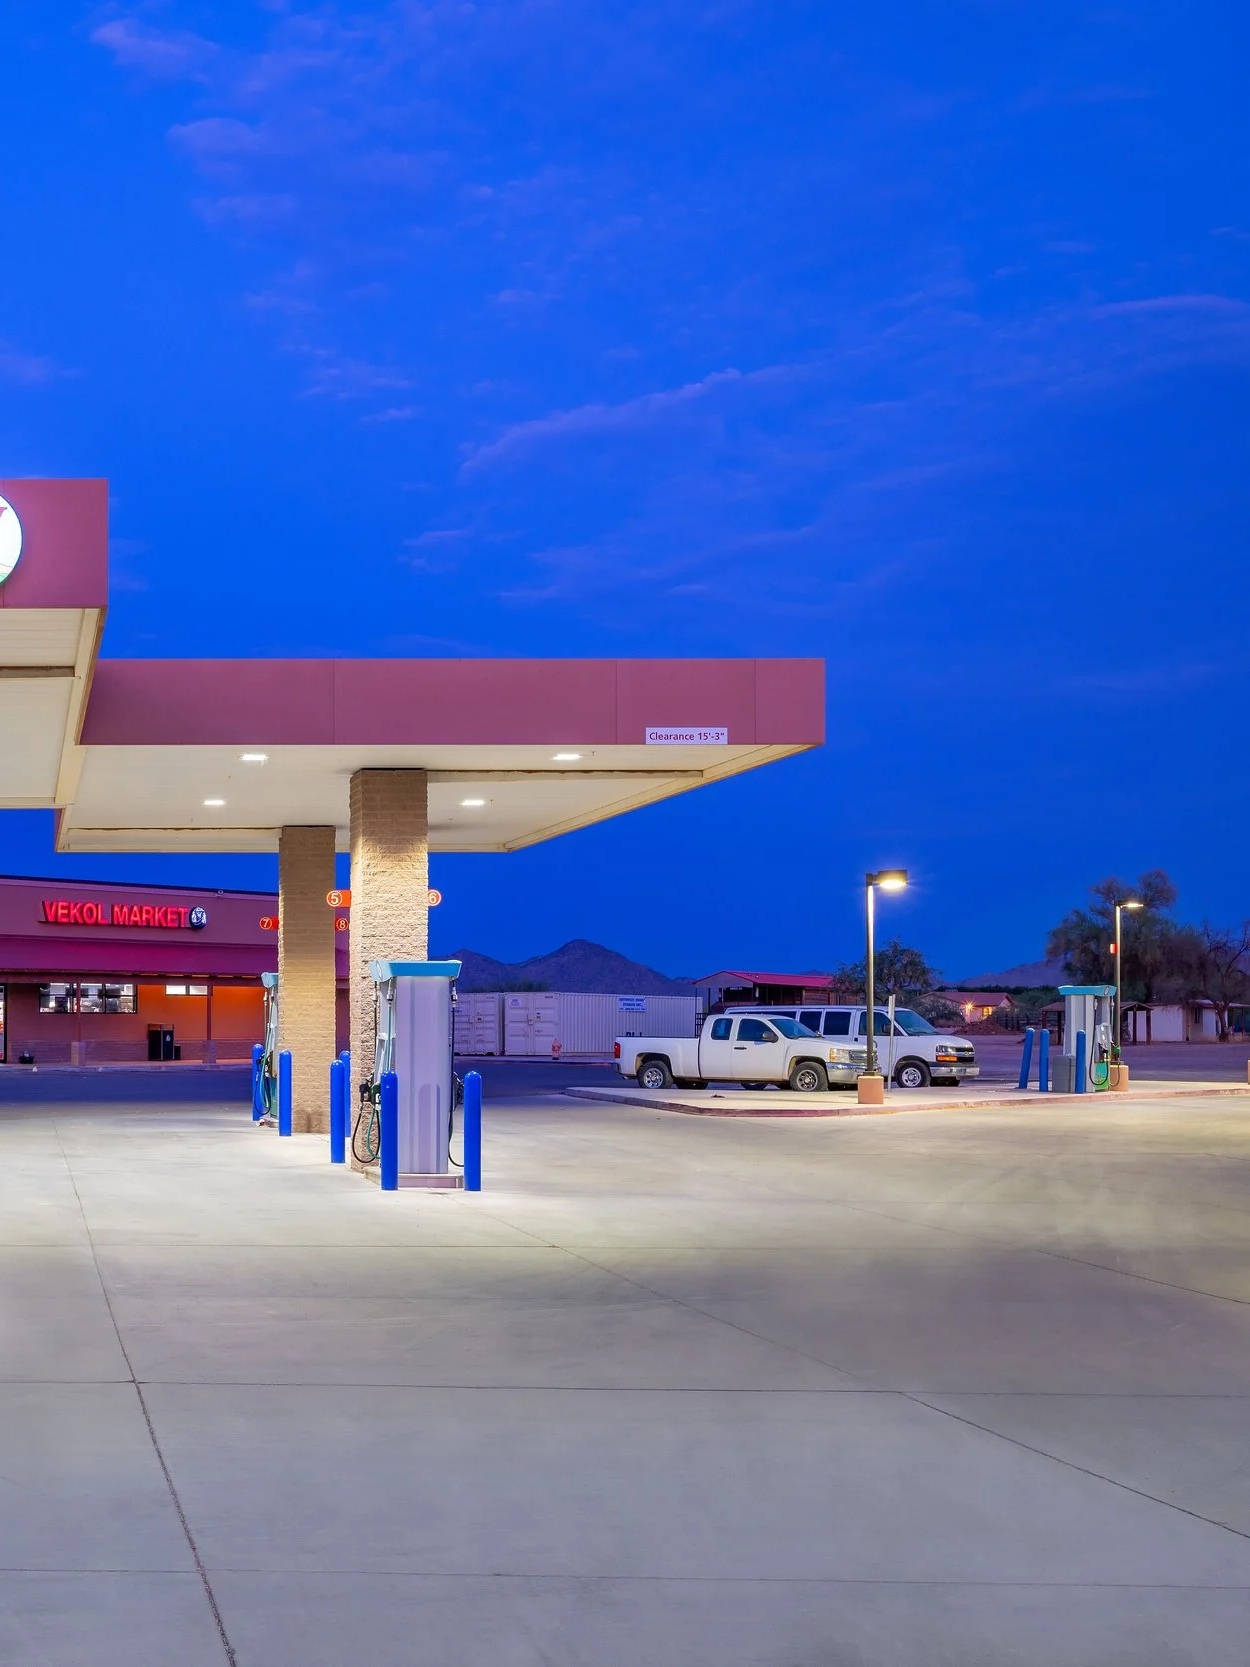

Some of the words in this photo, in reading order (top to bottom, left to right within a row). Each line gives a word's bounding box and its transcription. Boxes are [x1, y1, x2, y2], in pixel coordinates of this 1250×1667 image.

[649, 731, 695, 741] Clearance
[698, 731, 725, 741] 15'-3"
[330, 892, 339, 905] 5
[42, 900, 109, 924] VEKOL
[111, 903, 189, 928] MARKET
